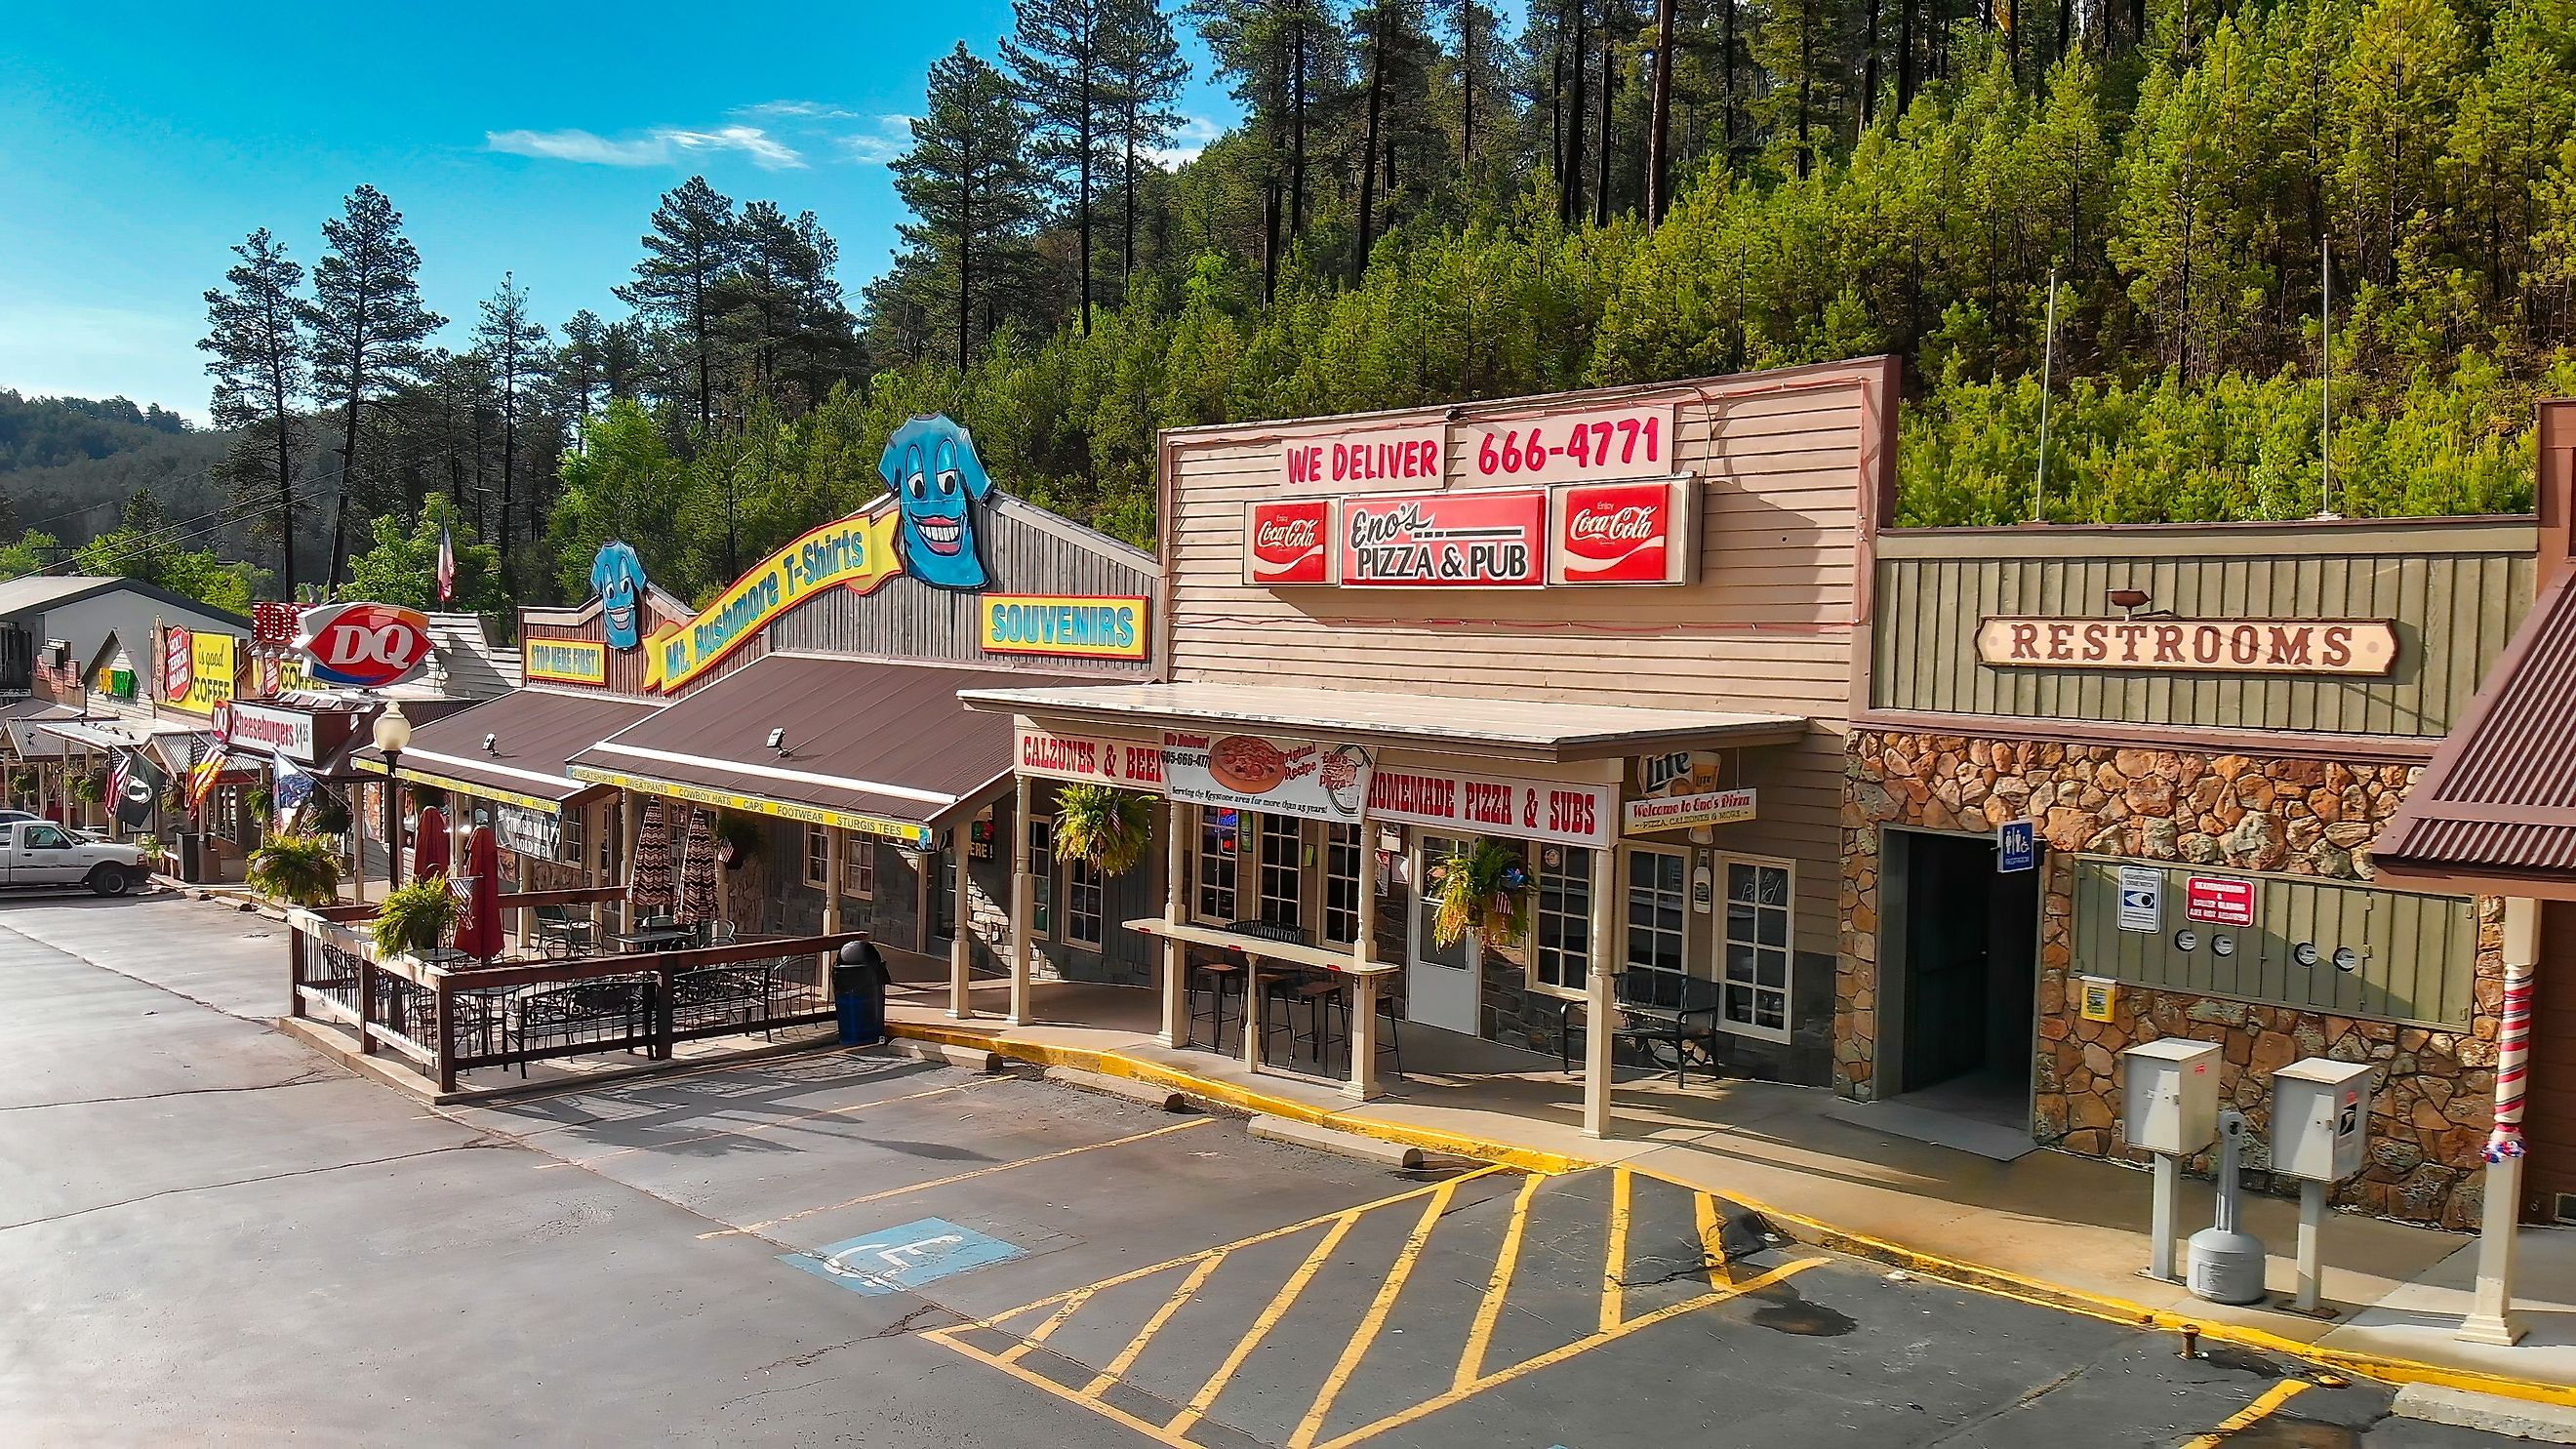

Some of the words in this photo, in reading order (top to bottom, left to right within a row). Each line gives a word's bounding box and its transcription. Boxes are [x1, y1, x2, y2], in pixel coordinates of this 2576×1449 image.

[1287, 445, 1322, 484] WE
[1332, 439, 1437, 482] DELIVER
[1478, 417, 1659, 476] 666-4771
[1351, 503, 1434, 549] Eno's
[1357, 543, 1433, 577] PIZZA
[1442, 546, 1463, 577] &
[1470, 544, 1526, 577] PUB
[252, 601, 312, 640] FUDG
[665, 638, 691, 682] Mt.
[694, 570, 781, 664] Rushmore
[784, 529, 864, 596] T-Shirts
[990, 603, 1134, 648] SOUVENIRS
[198, 644, 205, 664] is
[206, 643, 224, 675] good
[328, 624, 414, 669] DQ
[531, 644, 547, 671] STOP
[551, 645, 572, 674] HERE
[2010, 624, 2353, 667] RESTROOMS
[192, 676, 230, 703] COFFEE
[214, 706, 227, 738] DQ
[234, 709, 294, 748] Cheeseburgers
[1024, 735, 1096, 774] CALZONES
[1104, 744, 1117, 779] &
[1284, 761, 1317, 781] Recipe
[574, 769, 615, 785] SWEATSHIRTS
[624, 778, 668, 795] SWEATPANTS
[679, 788, 710, 802] COWBOY
[743, 800, 765, 813] CAPS
[1234, 795, 1249, 804] area
[1250, 795, 1263, 805] for
[1264, 799, 1280, 808] more
[1281, 799, 1297, 811] than
[1367, 772, 1455, 818] HOMEMADE
[1465, 781, 1512, 825] PIZZA
[1524, 787, 1539, 828] &
[1550, 789, 1595, 835] SUBS
[1633, 804, 1678, 818] Welcome
[1680, 800, 1691, 813] to
[1693, 795, 1718, 811] Eno's
[1721, 793, 1751, 808] Pizza
[777, 806, 824, 823] FOOTWEAR
[836, 816, 875, 832] STURGIS
[878, 824, 902, 836] TEES
